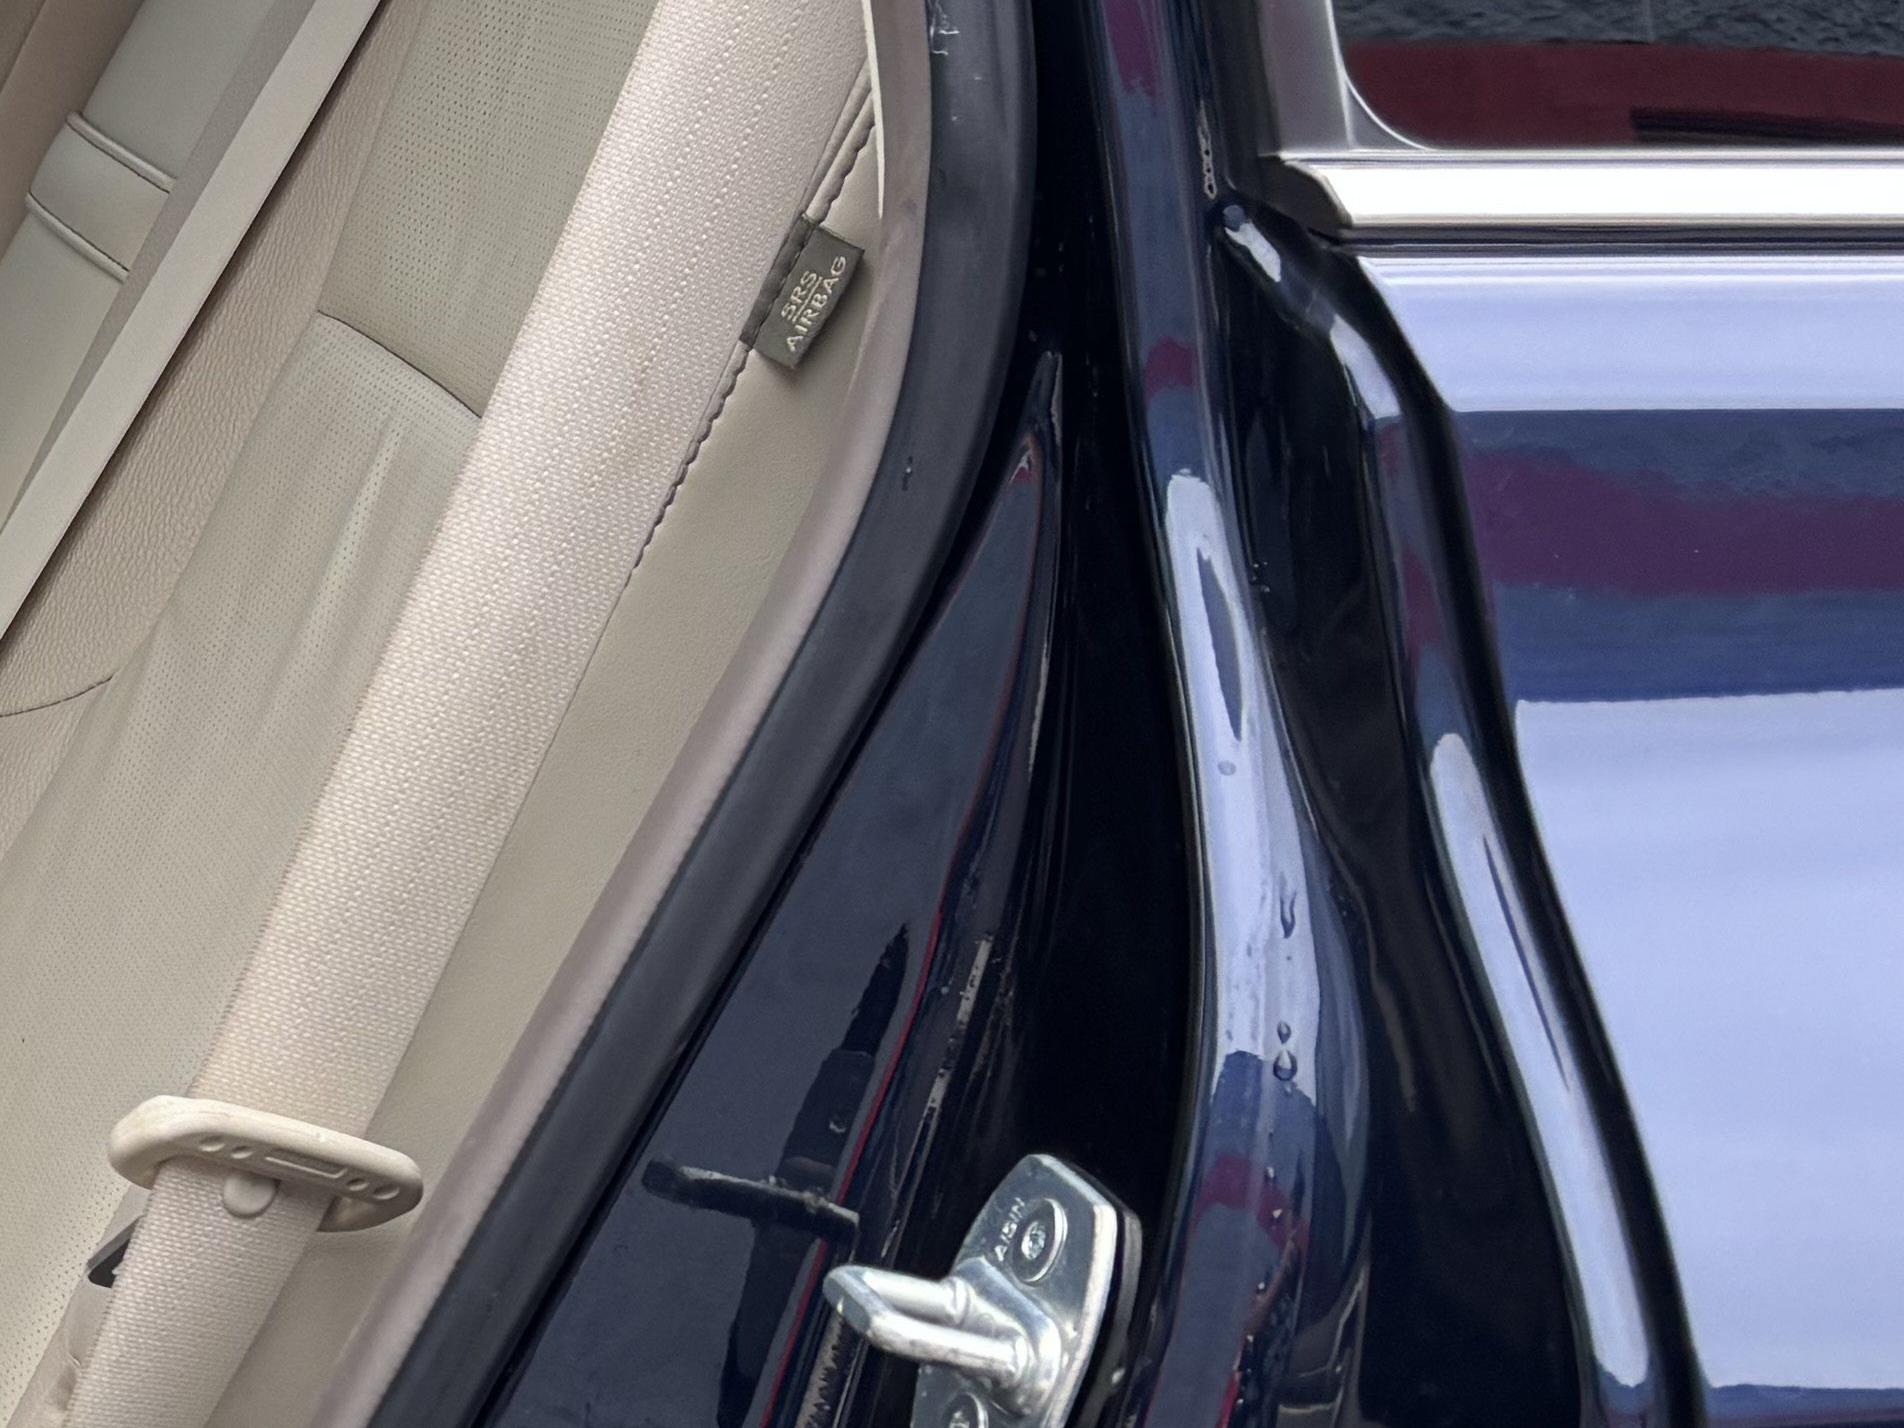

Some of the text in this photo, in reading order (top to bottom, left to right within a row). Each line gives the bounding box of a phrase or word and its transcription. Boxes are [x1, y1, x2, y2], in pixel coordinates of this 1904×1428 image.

[781, 270, 817, 321] SRS
[786, 256, 847, 352] AIRBAG
[994, 1197, 1025, 1262] AISIN
